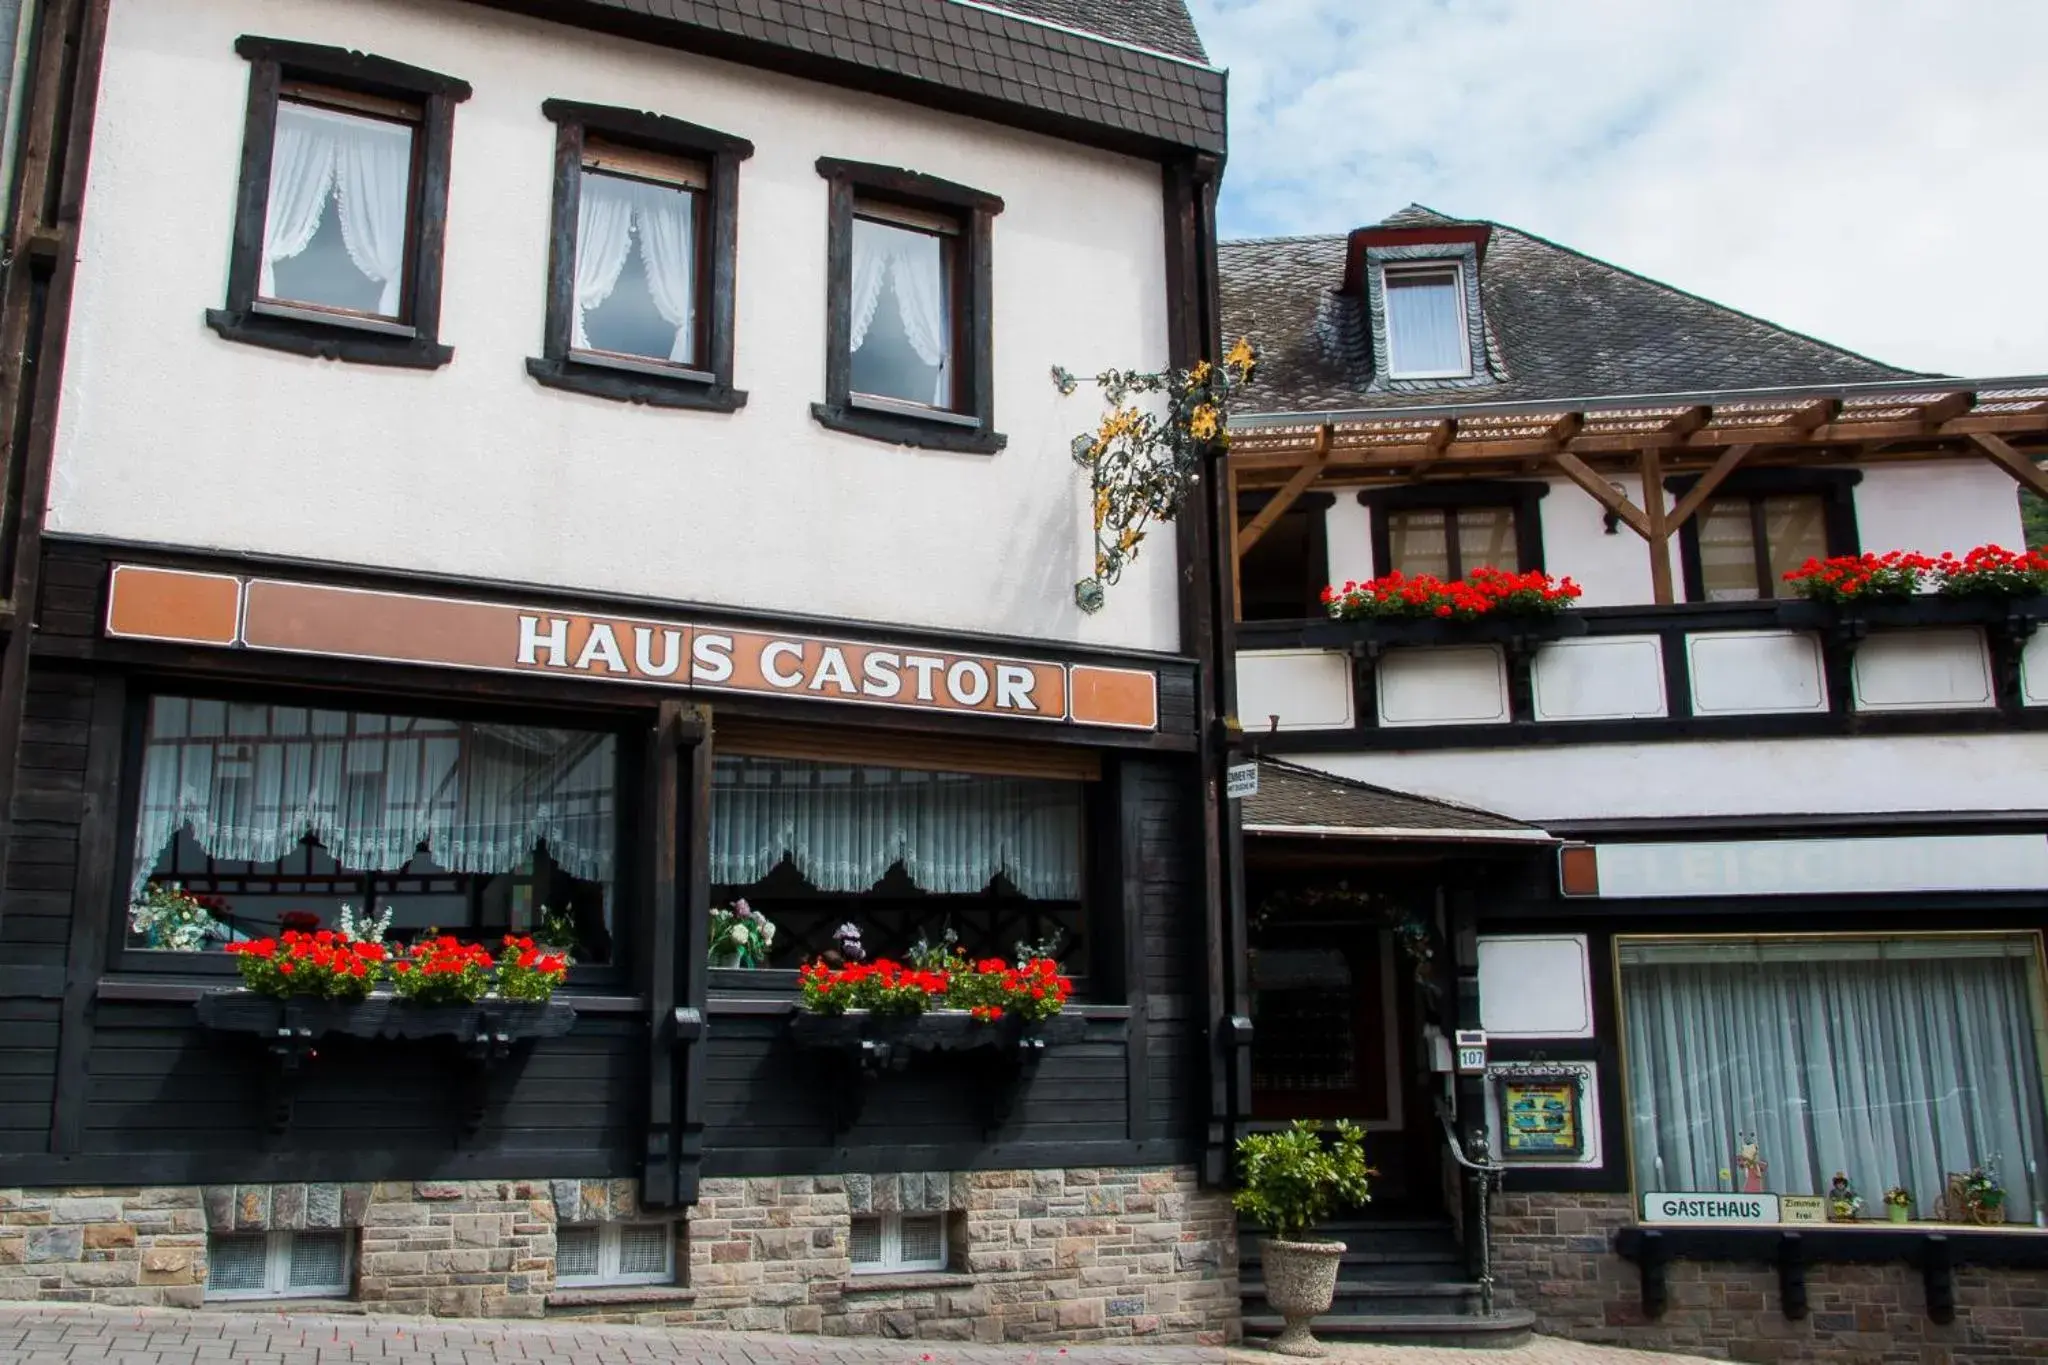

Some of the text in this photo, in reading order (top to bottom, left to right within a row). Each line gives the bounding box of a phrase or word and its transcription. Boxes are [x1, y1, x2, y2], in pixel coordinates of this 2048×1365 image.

[517, 615, 1039, 711] HAUS CASTOR
[1462, 1050, 1483, 1066] 107
[1785, 1199, 1821, 1208] Zimmer
[1796, 1211, 1813, 1219] frei
